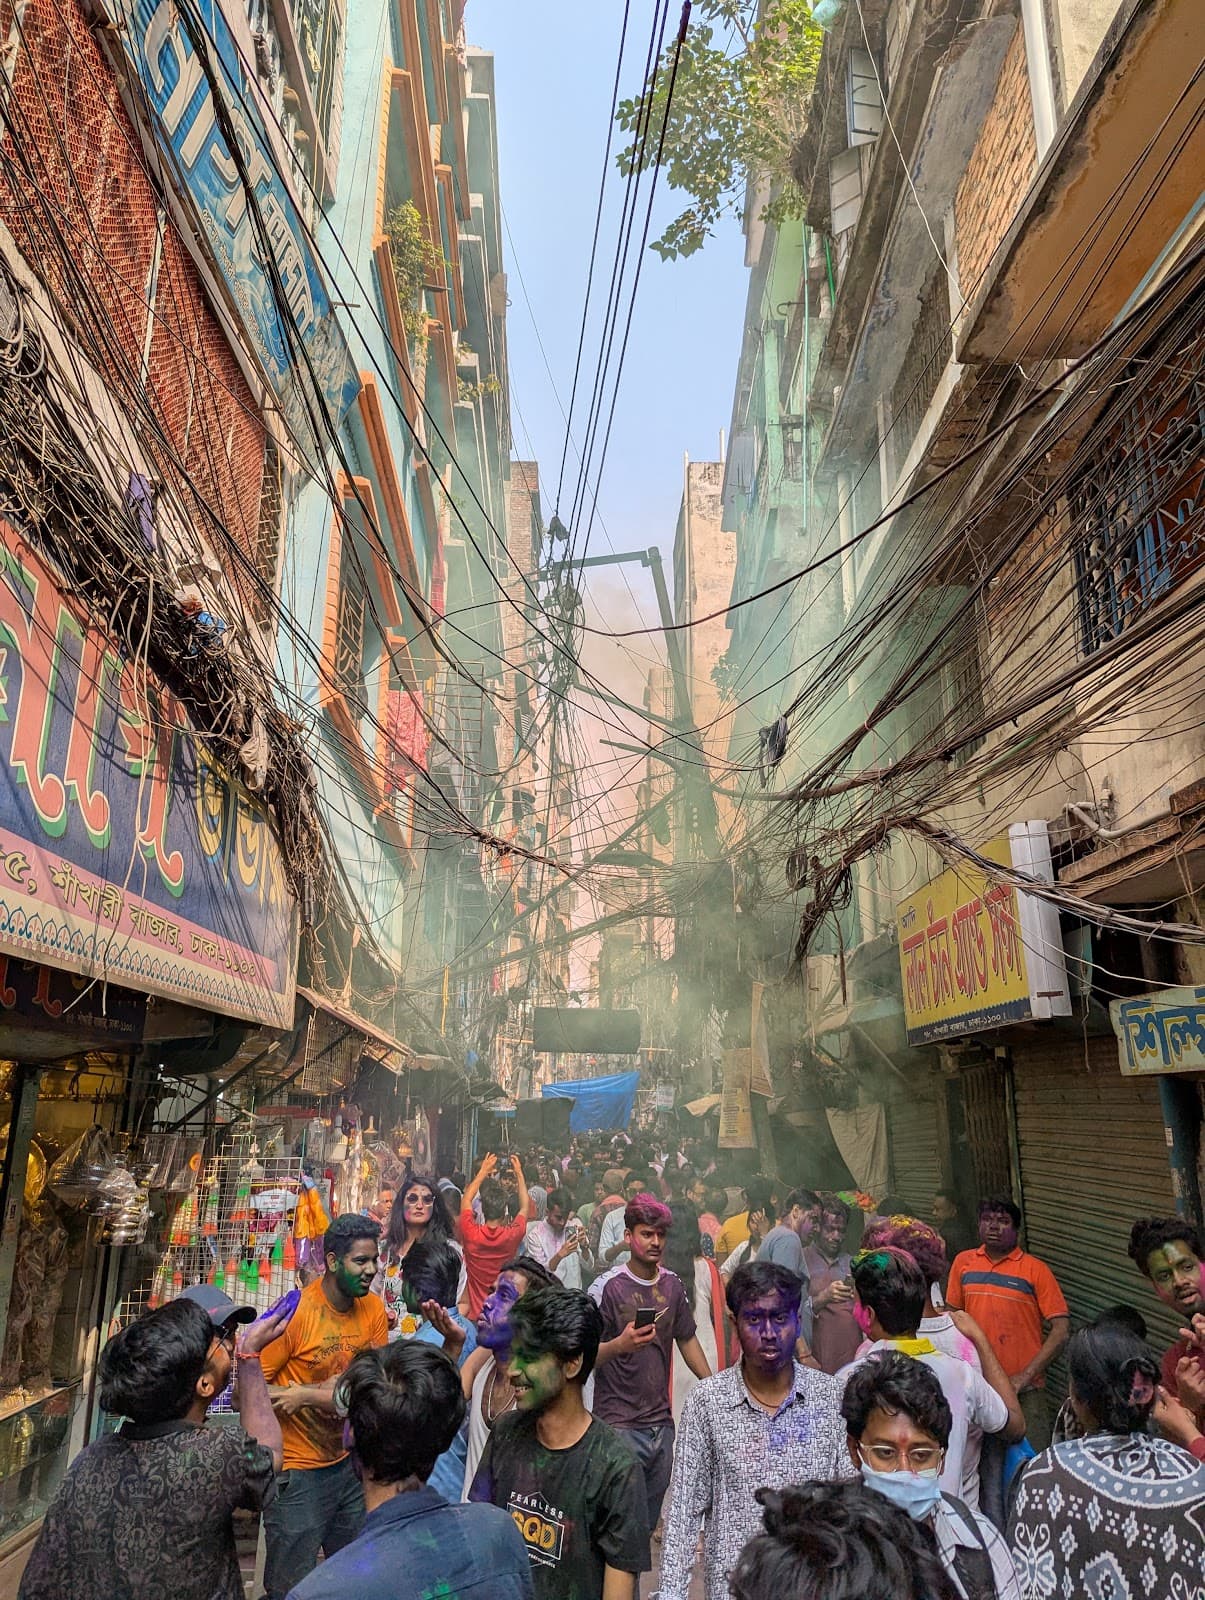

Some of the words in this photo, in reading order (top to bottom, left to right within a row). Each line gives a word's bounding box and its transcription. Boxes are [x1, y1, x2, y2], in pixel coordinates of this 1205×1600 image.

[50, 862, 122, 924] শাঁখারী
[130, 902, 184, 955] বাজার,
[189, 931, 257, 979] ঢাকা-১১০০
[511, 1491, 563, 1519] FEARLESS
